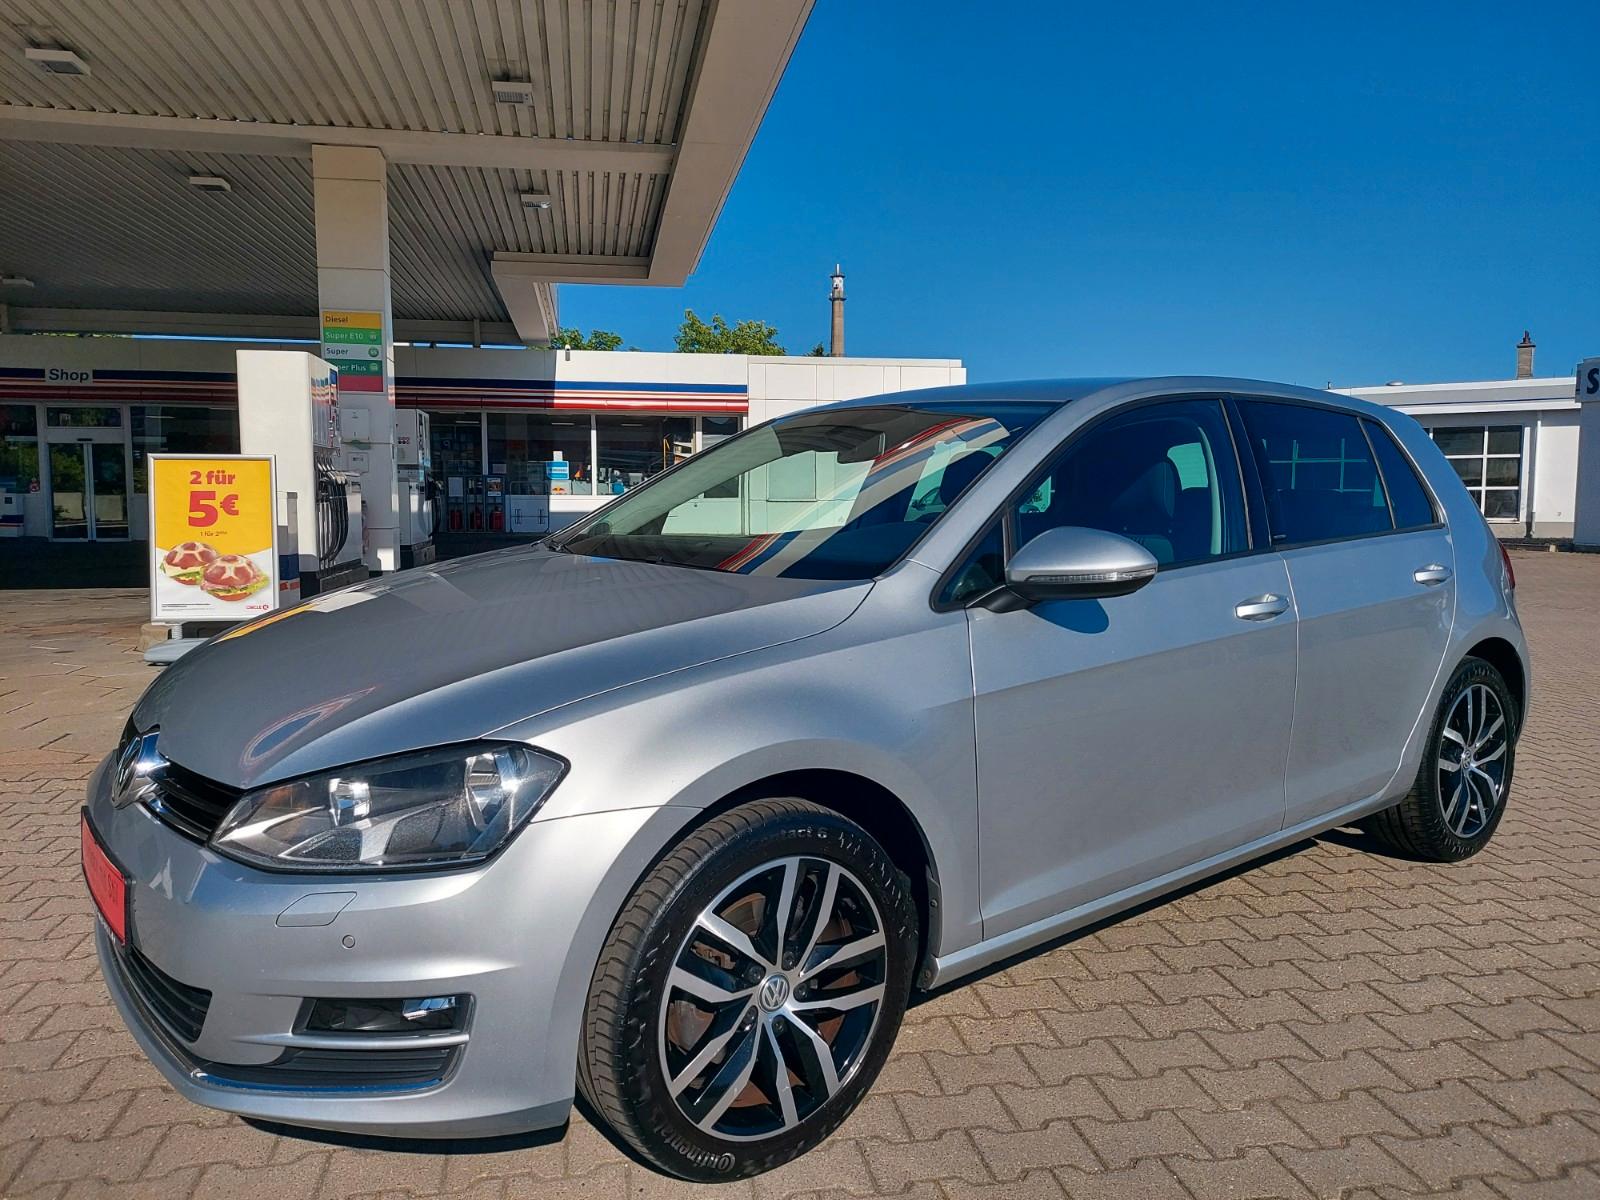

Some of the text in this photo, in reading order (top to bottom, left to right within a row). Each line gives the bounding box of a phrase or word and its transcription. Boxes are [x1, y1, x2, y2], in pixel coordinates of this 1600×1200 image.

[325, 315, 349, 323] Diesel
[325, 332, 348, 341] Super
[349, 332, 364, 340] E10
[326, 347, 349, 356] Super
[351, 363, 367, 372] Plus
[48, 368, 89, 383] Shop
[189, 469, 236, 485] 2 für
[188, 490, 240, 527] 5€
